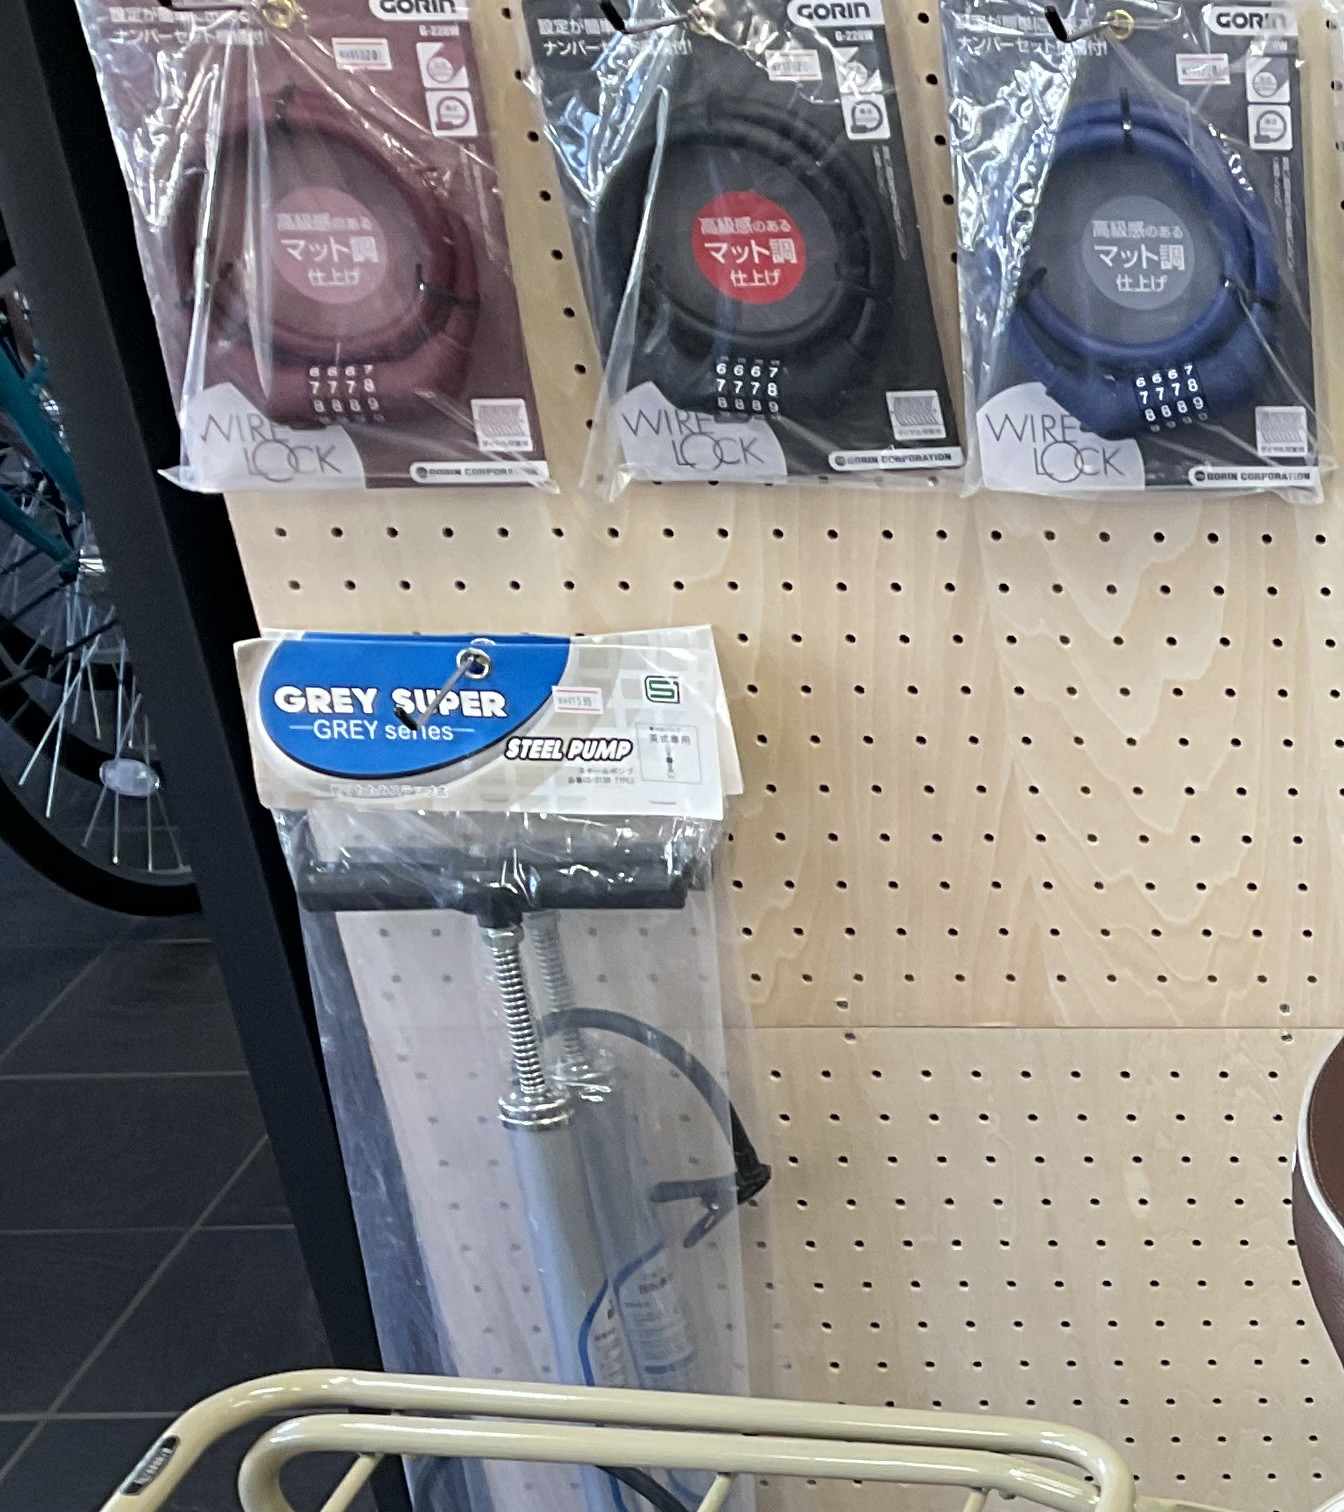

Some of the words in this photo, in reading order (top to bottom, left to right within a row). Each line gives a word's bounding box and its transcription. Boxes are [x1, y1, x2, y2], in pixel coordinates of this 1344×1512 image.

[797, 2, 871, 20] GORIN
[704, 238, 798, 265] マット調
[1094, 243, 1186, 271] マット調
[730, 269, 781, 287] 仕上げ
[1116, 274, 1168, 293] 仕上げ
[621, 409, 714, 436] WIRE
[985, 413, 1079, 442] WIRE
[672, 432, 765, 472] LOCK
[1033, 441, 1125, 483] LOCK
[273, 685, 379, 715] GREY
[390, 686, 508, 719] SUPER
[312, 718, 379, 741] GREY
[505, 736, 564, 761] STEEL
[566, 737, 634, 761] PUMP
